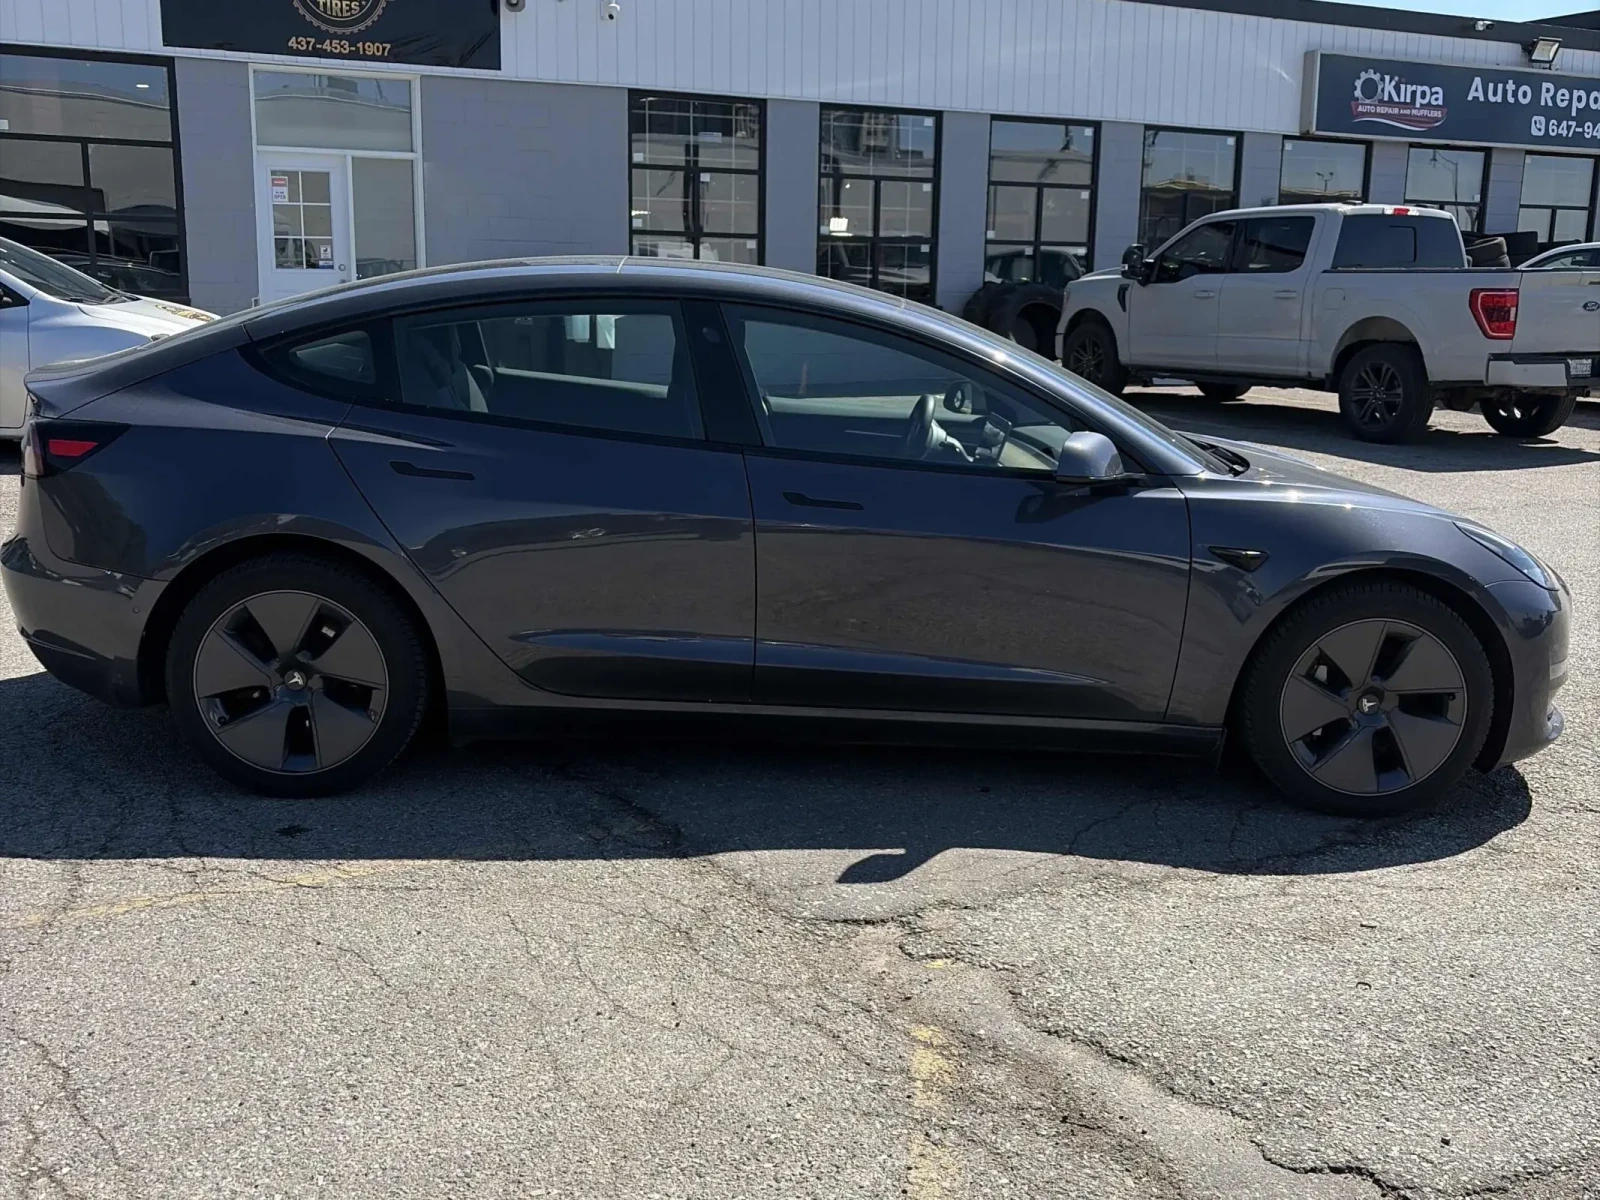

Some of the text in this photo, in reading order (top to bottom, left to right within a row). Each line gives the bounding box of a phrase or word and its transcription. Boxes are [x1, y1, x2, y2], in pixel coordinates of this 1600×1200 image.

[317, 0, 360, 17] TIRES
[287, 36, 391, 56] 437-453-1907
[1383, 74, 1443, 108] Kirpa
[1467, 76, 1532, 105] Auto
[1357, 104, 1376, 113] AUTO
[1376, 106, 1399, 115] REPAIR
[1411, 109, 1442, 118] MUFFLERS
[1548, 119, 1600, 139] 647-94
